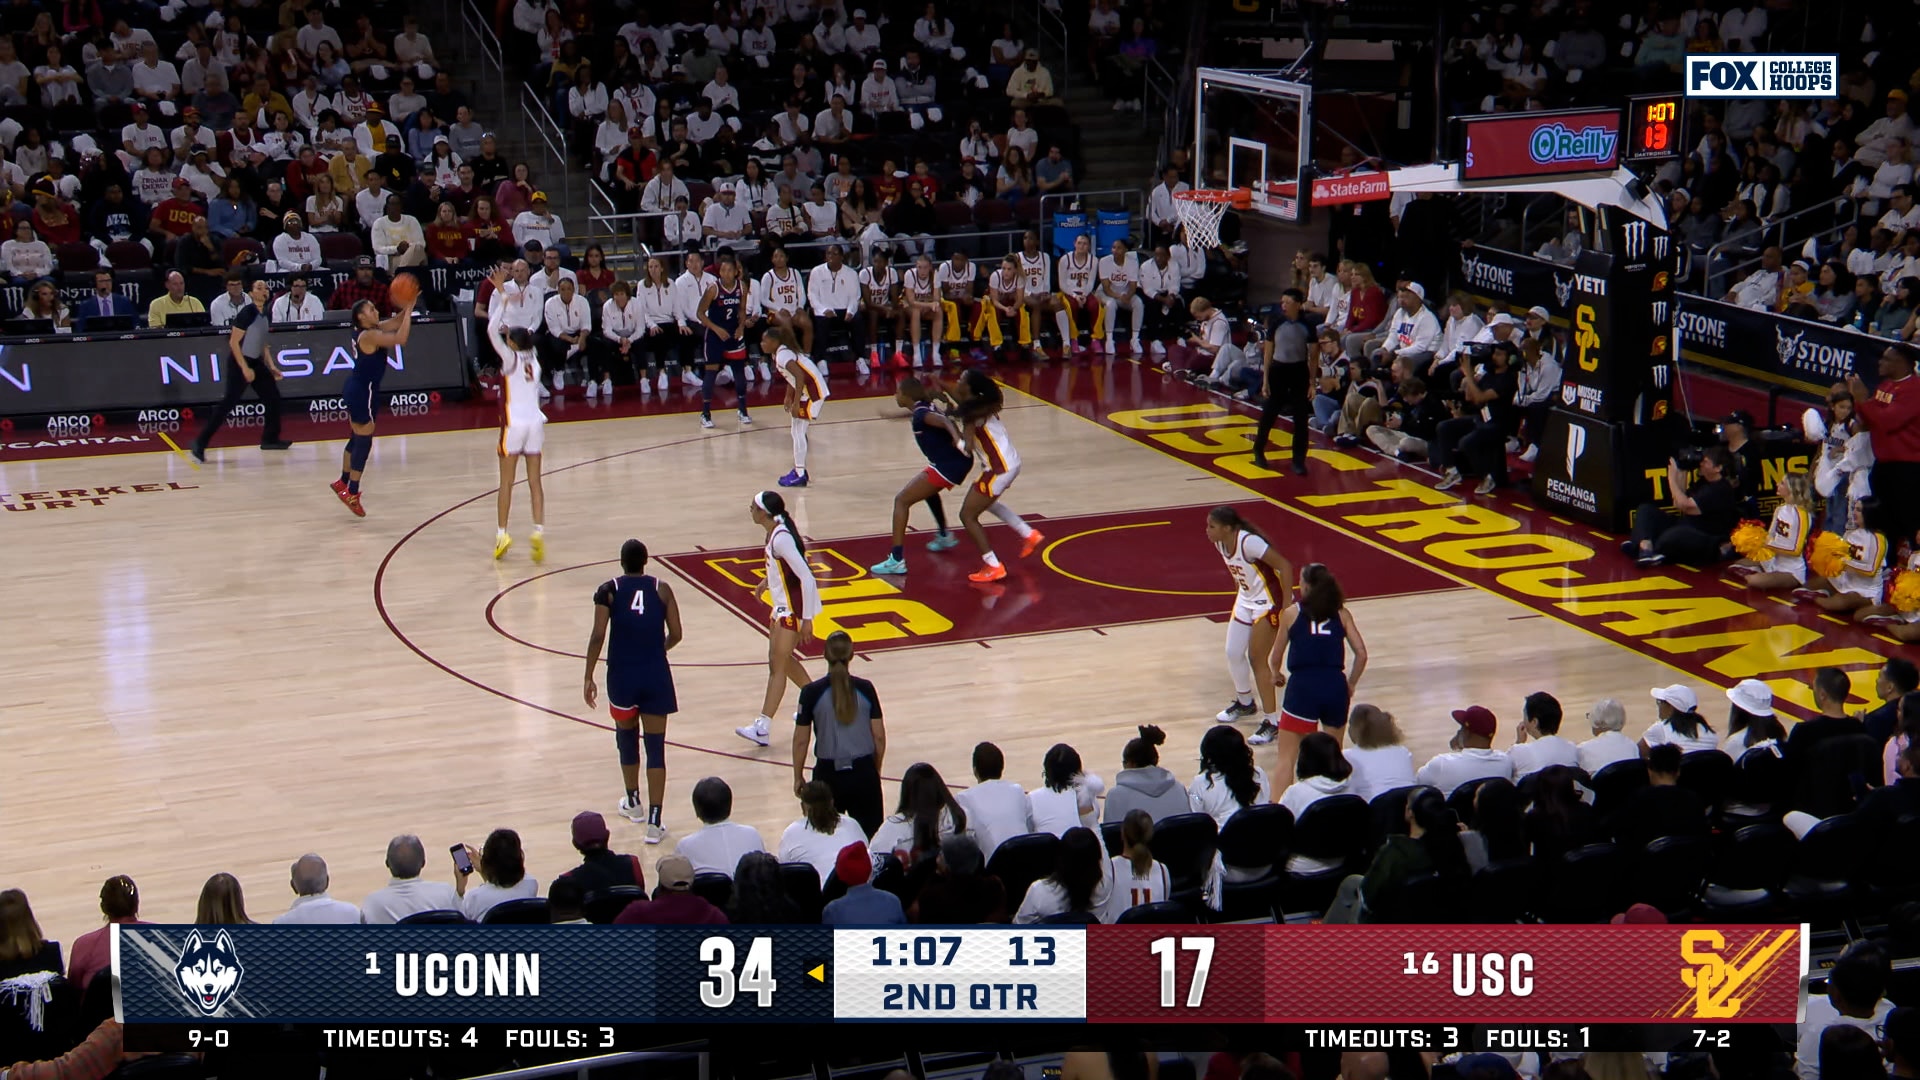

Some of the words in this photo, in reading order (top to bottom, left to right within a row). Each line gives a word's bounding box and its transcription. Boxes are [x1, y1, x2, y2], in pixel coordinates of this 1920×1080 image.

[1647, 102, 1675, 122] 1:07
[1533, 125, 1616, 159] O'Reilly
[1645, 123, 1668, 149] 13
[1024, 268, 1041, 276] USC
[1475, 262, 1513, 287] STONE
[777, 285, 795, 294] USC
[1031, 277, 1037, 286] 6
[1475, 279, 1513, 295] BREWING
[1575, 273, 1607, 296] YETI
[783, 295, 793, 304] 10
[726, 308, 733, 320] 2
[1679, 311, 1727, 339] STONE
[1797, 341, 1855, 369] STONE
[390, 393, 428, 406] ARCO
[47, 415, 90, 428] ARCO
[138, 409, 179, 422] ARCO
[1547, 478, 1596, 504] PECHANGA
[1547, 490, 1571, 505] RESORT
[630, 589, 645, 614] 4
